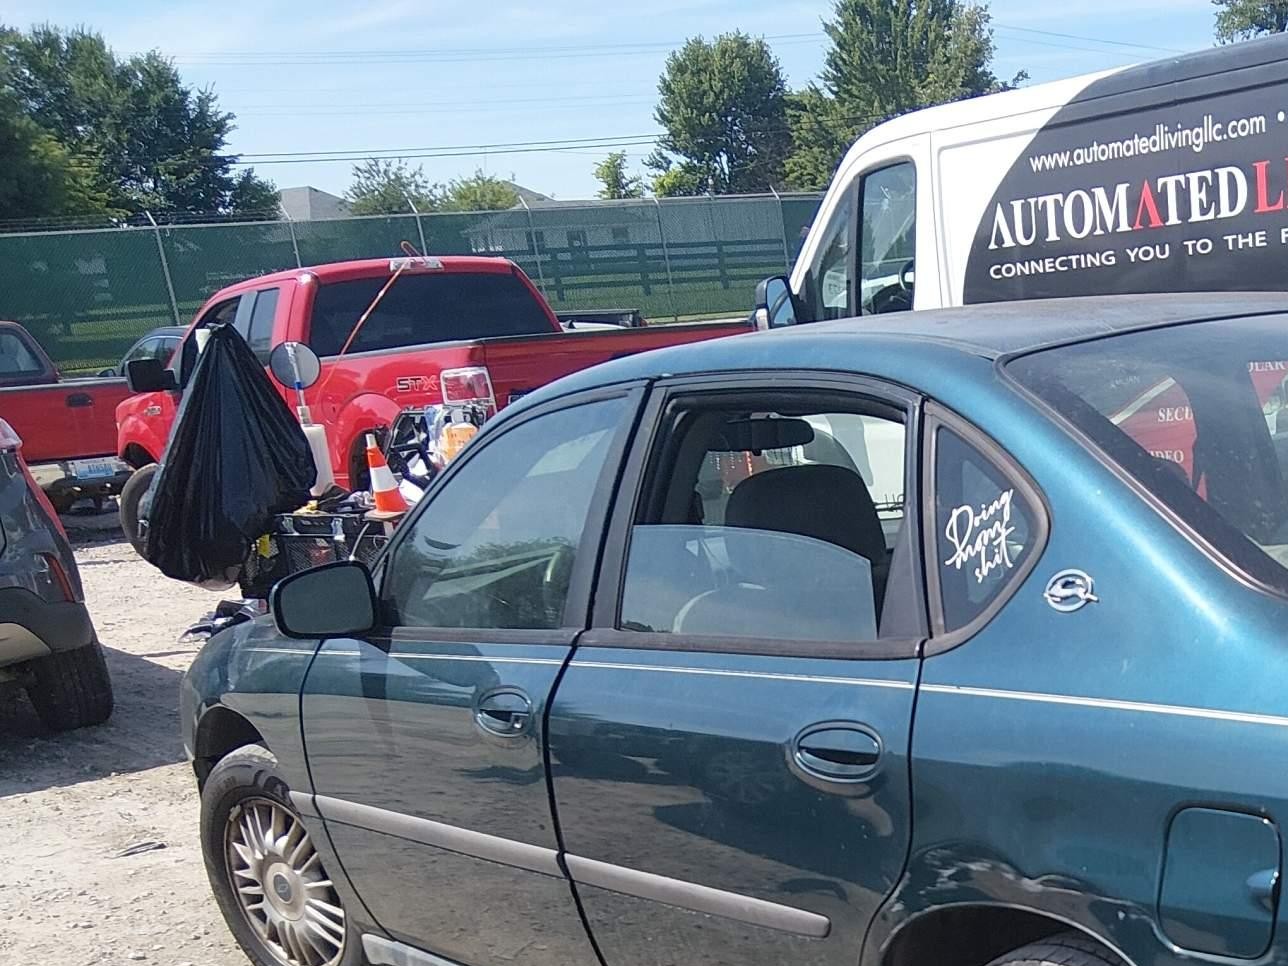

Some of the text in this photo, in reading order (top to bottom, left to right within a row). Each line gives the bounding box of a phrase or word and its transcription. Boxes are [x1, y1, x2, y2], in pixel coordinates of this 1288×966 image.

[1029, 115, 1266, 172] www.automatedlivingllc.com
[988, 166, 1248, 250] AUTOMATED
[989, 251, 1116, 280] CONNECTING
[1126, 243, 1170, 263] YOU
[1183, 237, 1213, 256] TO
[1223, 230, 1267, 250] THE
[396, 375, 438, 392] STX
[944, 489, 1013, 562] Doing
[975, 526, 1015, 583] shit
